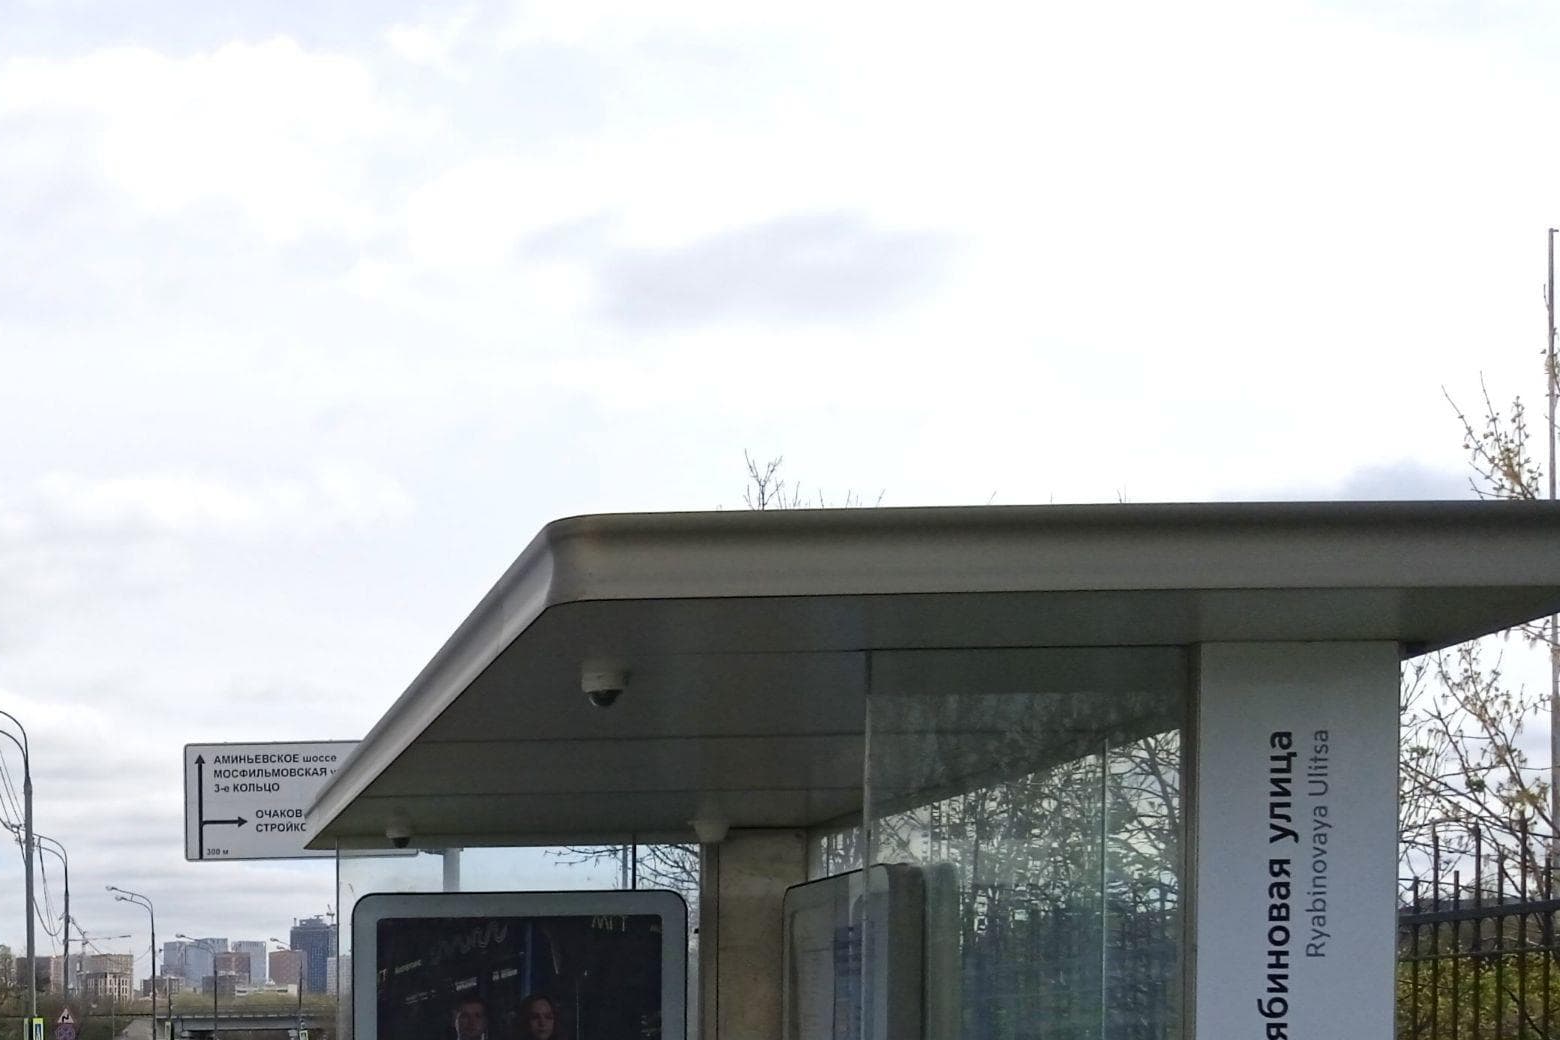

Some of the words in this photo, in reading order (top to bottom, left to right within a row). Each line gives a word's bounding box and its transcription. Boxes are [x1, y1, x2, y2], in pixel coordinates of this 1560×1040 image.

[213, 753, 300, 764] АМИНЬЕВСКОЕ
[302, 754, 337, 763] шоссе
[1307, 729, 1329, 797] Ulitsa
[213, 767, 327, 778] МОСФИЛЬМОВСКАЯ
[233, 782, 280, 793] КОЛЬЦО
[1268, 731, 1300, 844] улица
[255, 808, 303, 819] ОЧАКОВ
[206, 848, 221, 856] 300
[1305, 805, 1332, 957] Ryabinovaya
